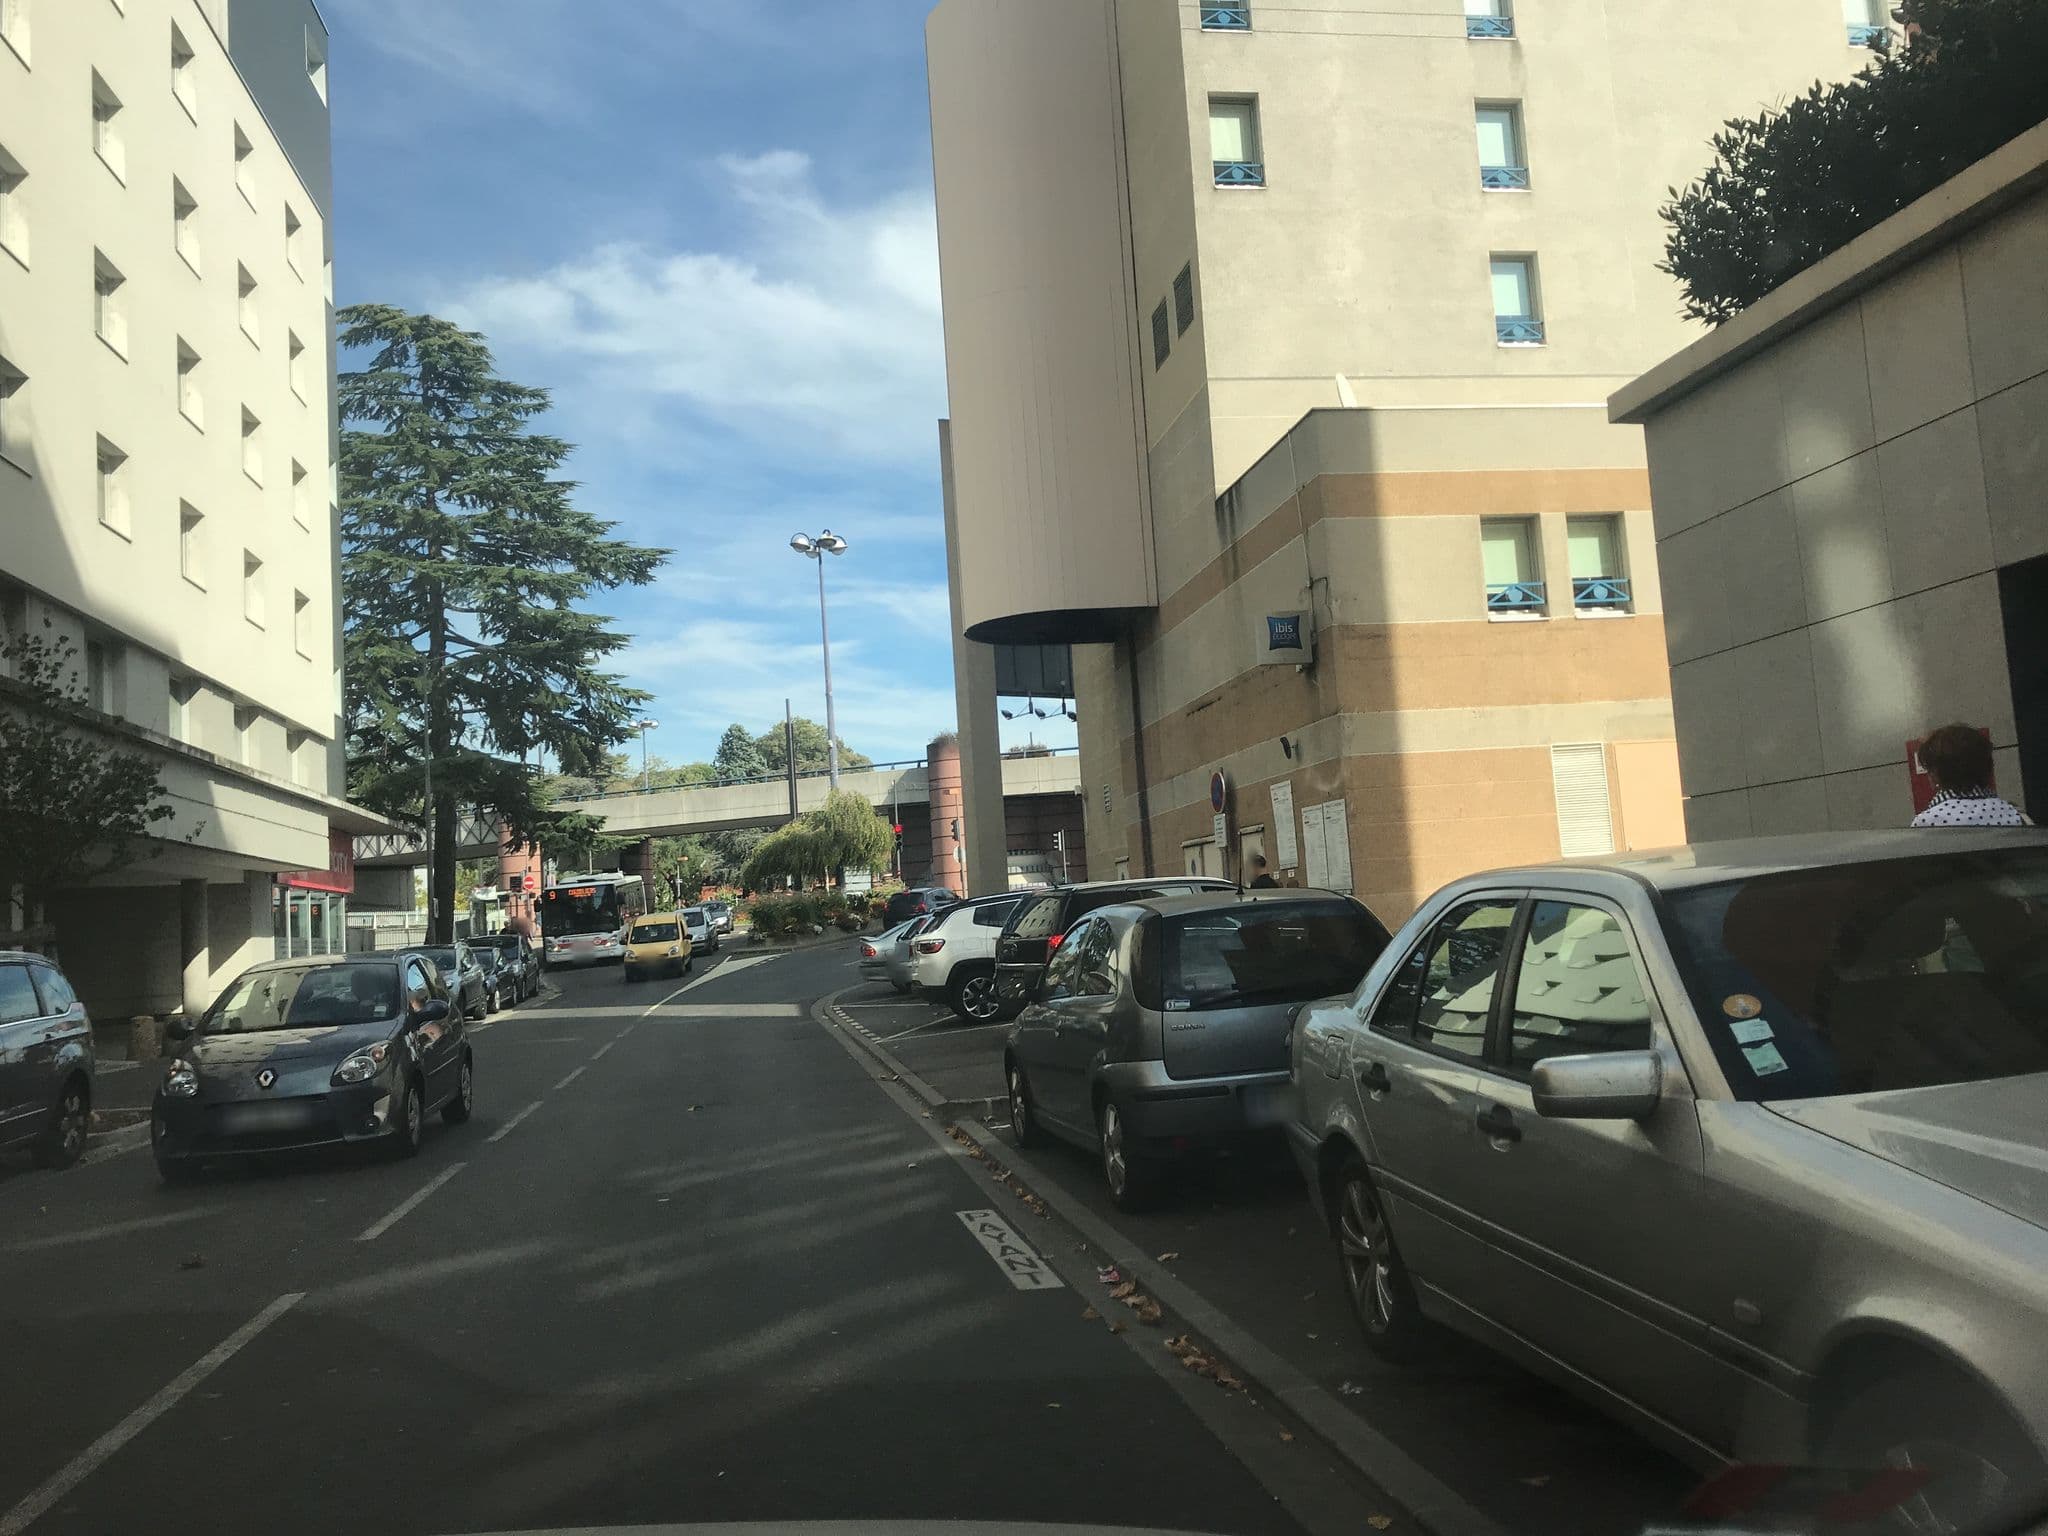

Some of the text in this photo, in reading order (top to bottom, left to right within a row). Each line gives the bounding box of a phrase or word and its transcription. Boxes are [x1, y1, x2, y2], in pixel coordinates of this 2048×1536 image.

[1275, 622, 1294, 633] ibis
[549, 890, 556, 900] 9
[964, 1212, 1042, 1286] PAYANT
